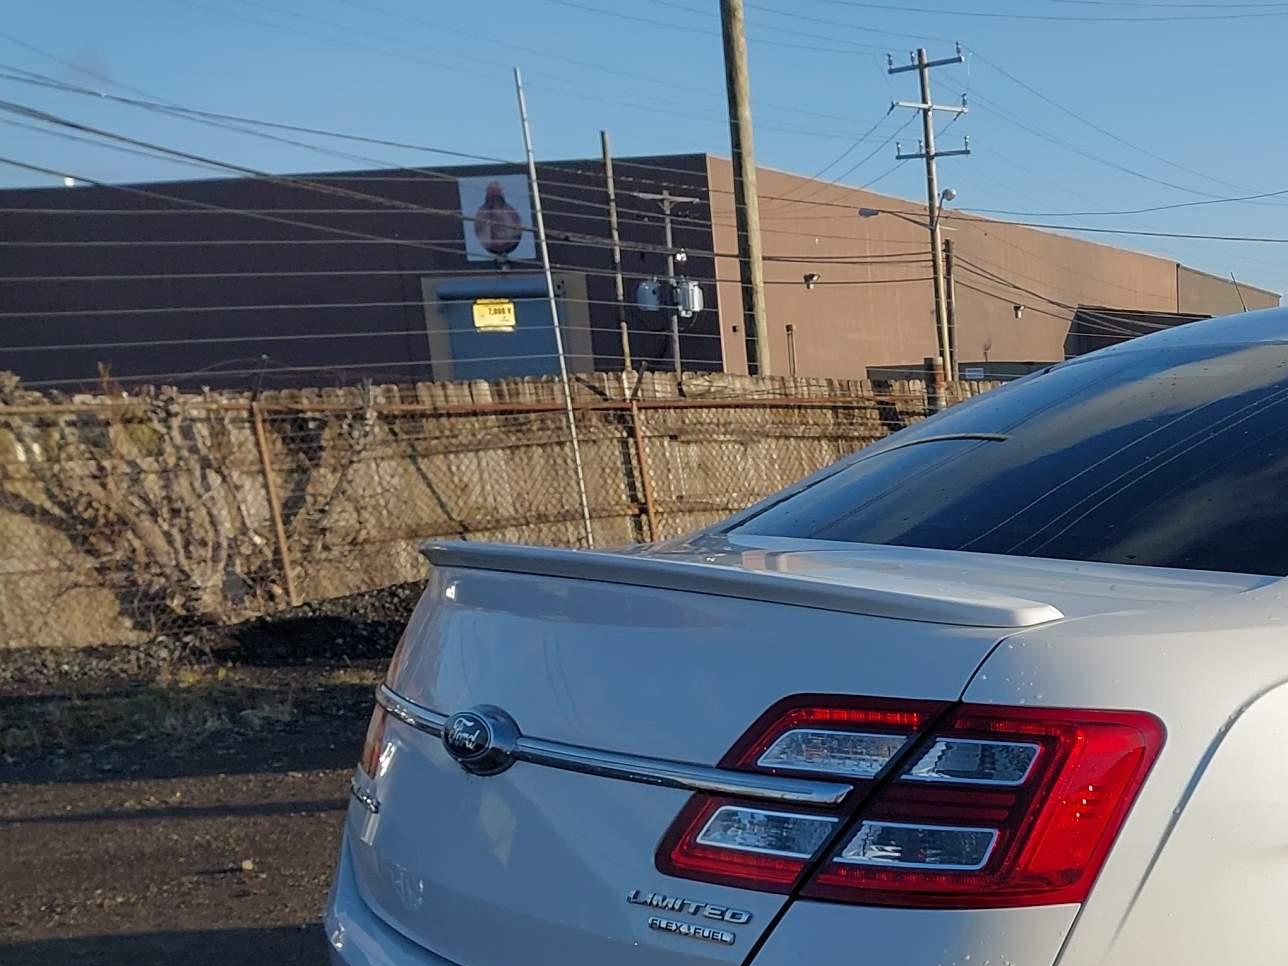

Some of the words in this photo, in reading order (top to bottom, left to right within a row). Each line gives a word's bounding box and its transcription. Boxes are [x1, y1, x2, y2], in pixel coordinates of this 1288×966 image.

[448, 717, 481, 745] Ford
[627, 889, 753, 924] LIMITED
[649, 917, 684, 933] FLEX
[693, 926, 731, 944] FUEL
